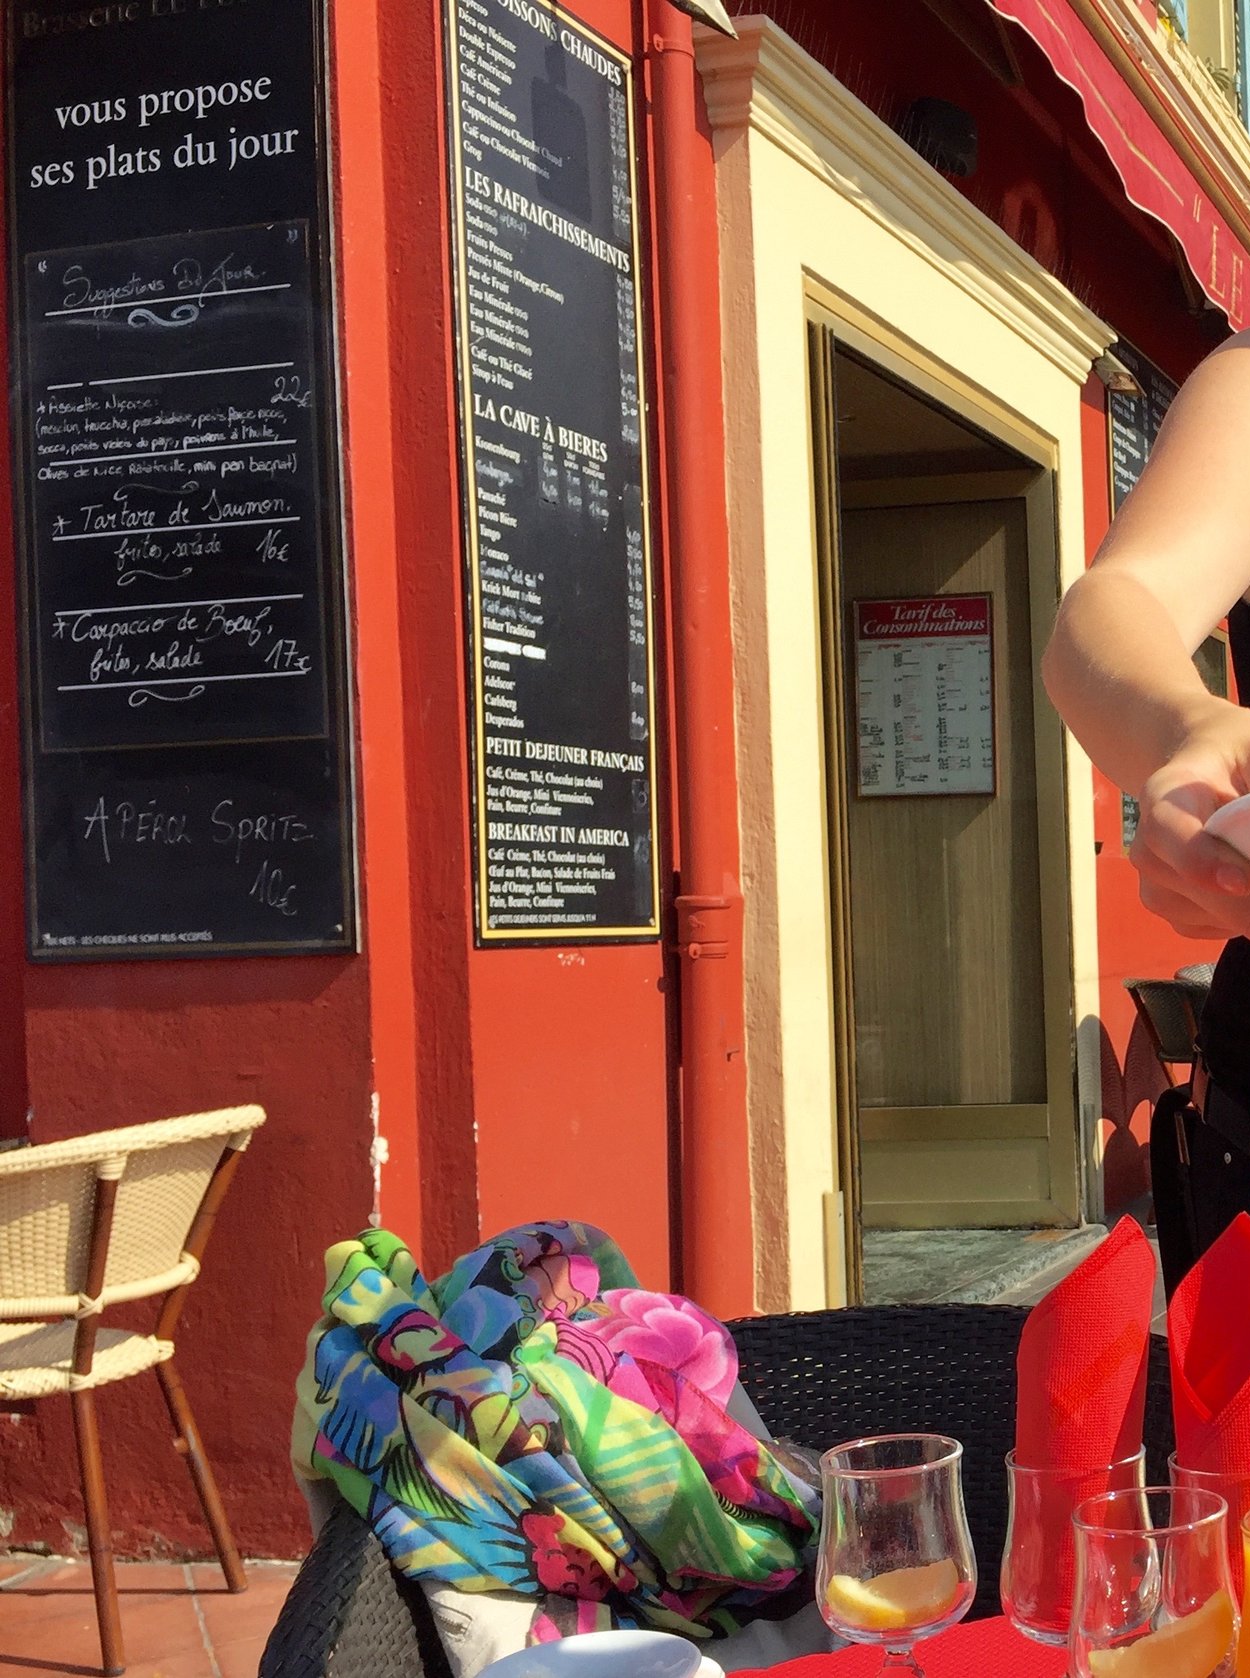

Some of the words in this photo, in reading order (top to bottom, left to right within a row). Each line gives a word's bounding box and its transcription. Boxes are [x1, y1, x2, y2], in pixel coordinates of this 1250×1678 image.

[459, 44, 476, 63] Café
[560, 29, 623, 87] CHAUDES
[460, 62, 477, 81] Café
[55, 97, 127, 130] vous
[138, 75, 272, 127] propose
[461, 80, 475, 98] Thé
[30, 160, 75, 188] ses
[86, 144, 162, 190] plats
[173, 133, 218, 169] du
[228, 127, 299, 171] jour
[465, 166, 491, 198] LES
[473, 393, 497, 422] LA
[500, 404, 540, 438] CAVE
[543, 416, 555, 444] À
[558, 426, 609, 463] BIERES
[221, 460, 246, 479] pan
[80, 500, 156, 532] Tartare
[168, 500, 191, 526] de
[863, 615, 986, 636] Consommations
[891, 603, 932, 622] Tarif
[932, 603, 957, 619] des
[71, 612, 178, 650] Carpaccio
[177, 608, 199, 632] de
[486, 736, 522, 758] PETIT
[525, 741, 588, 766] DEJEUNER
[590, 750, 645, 773] FRANÇAIS
[488, 822, 559, 843] BREAKFAST
[560, 826, 576, 844] IN
[578, 828, 630, 847] AMERICA
